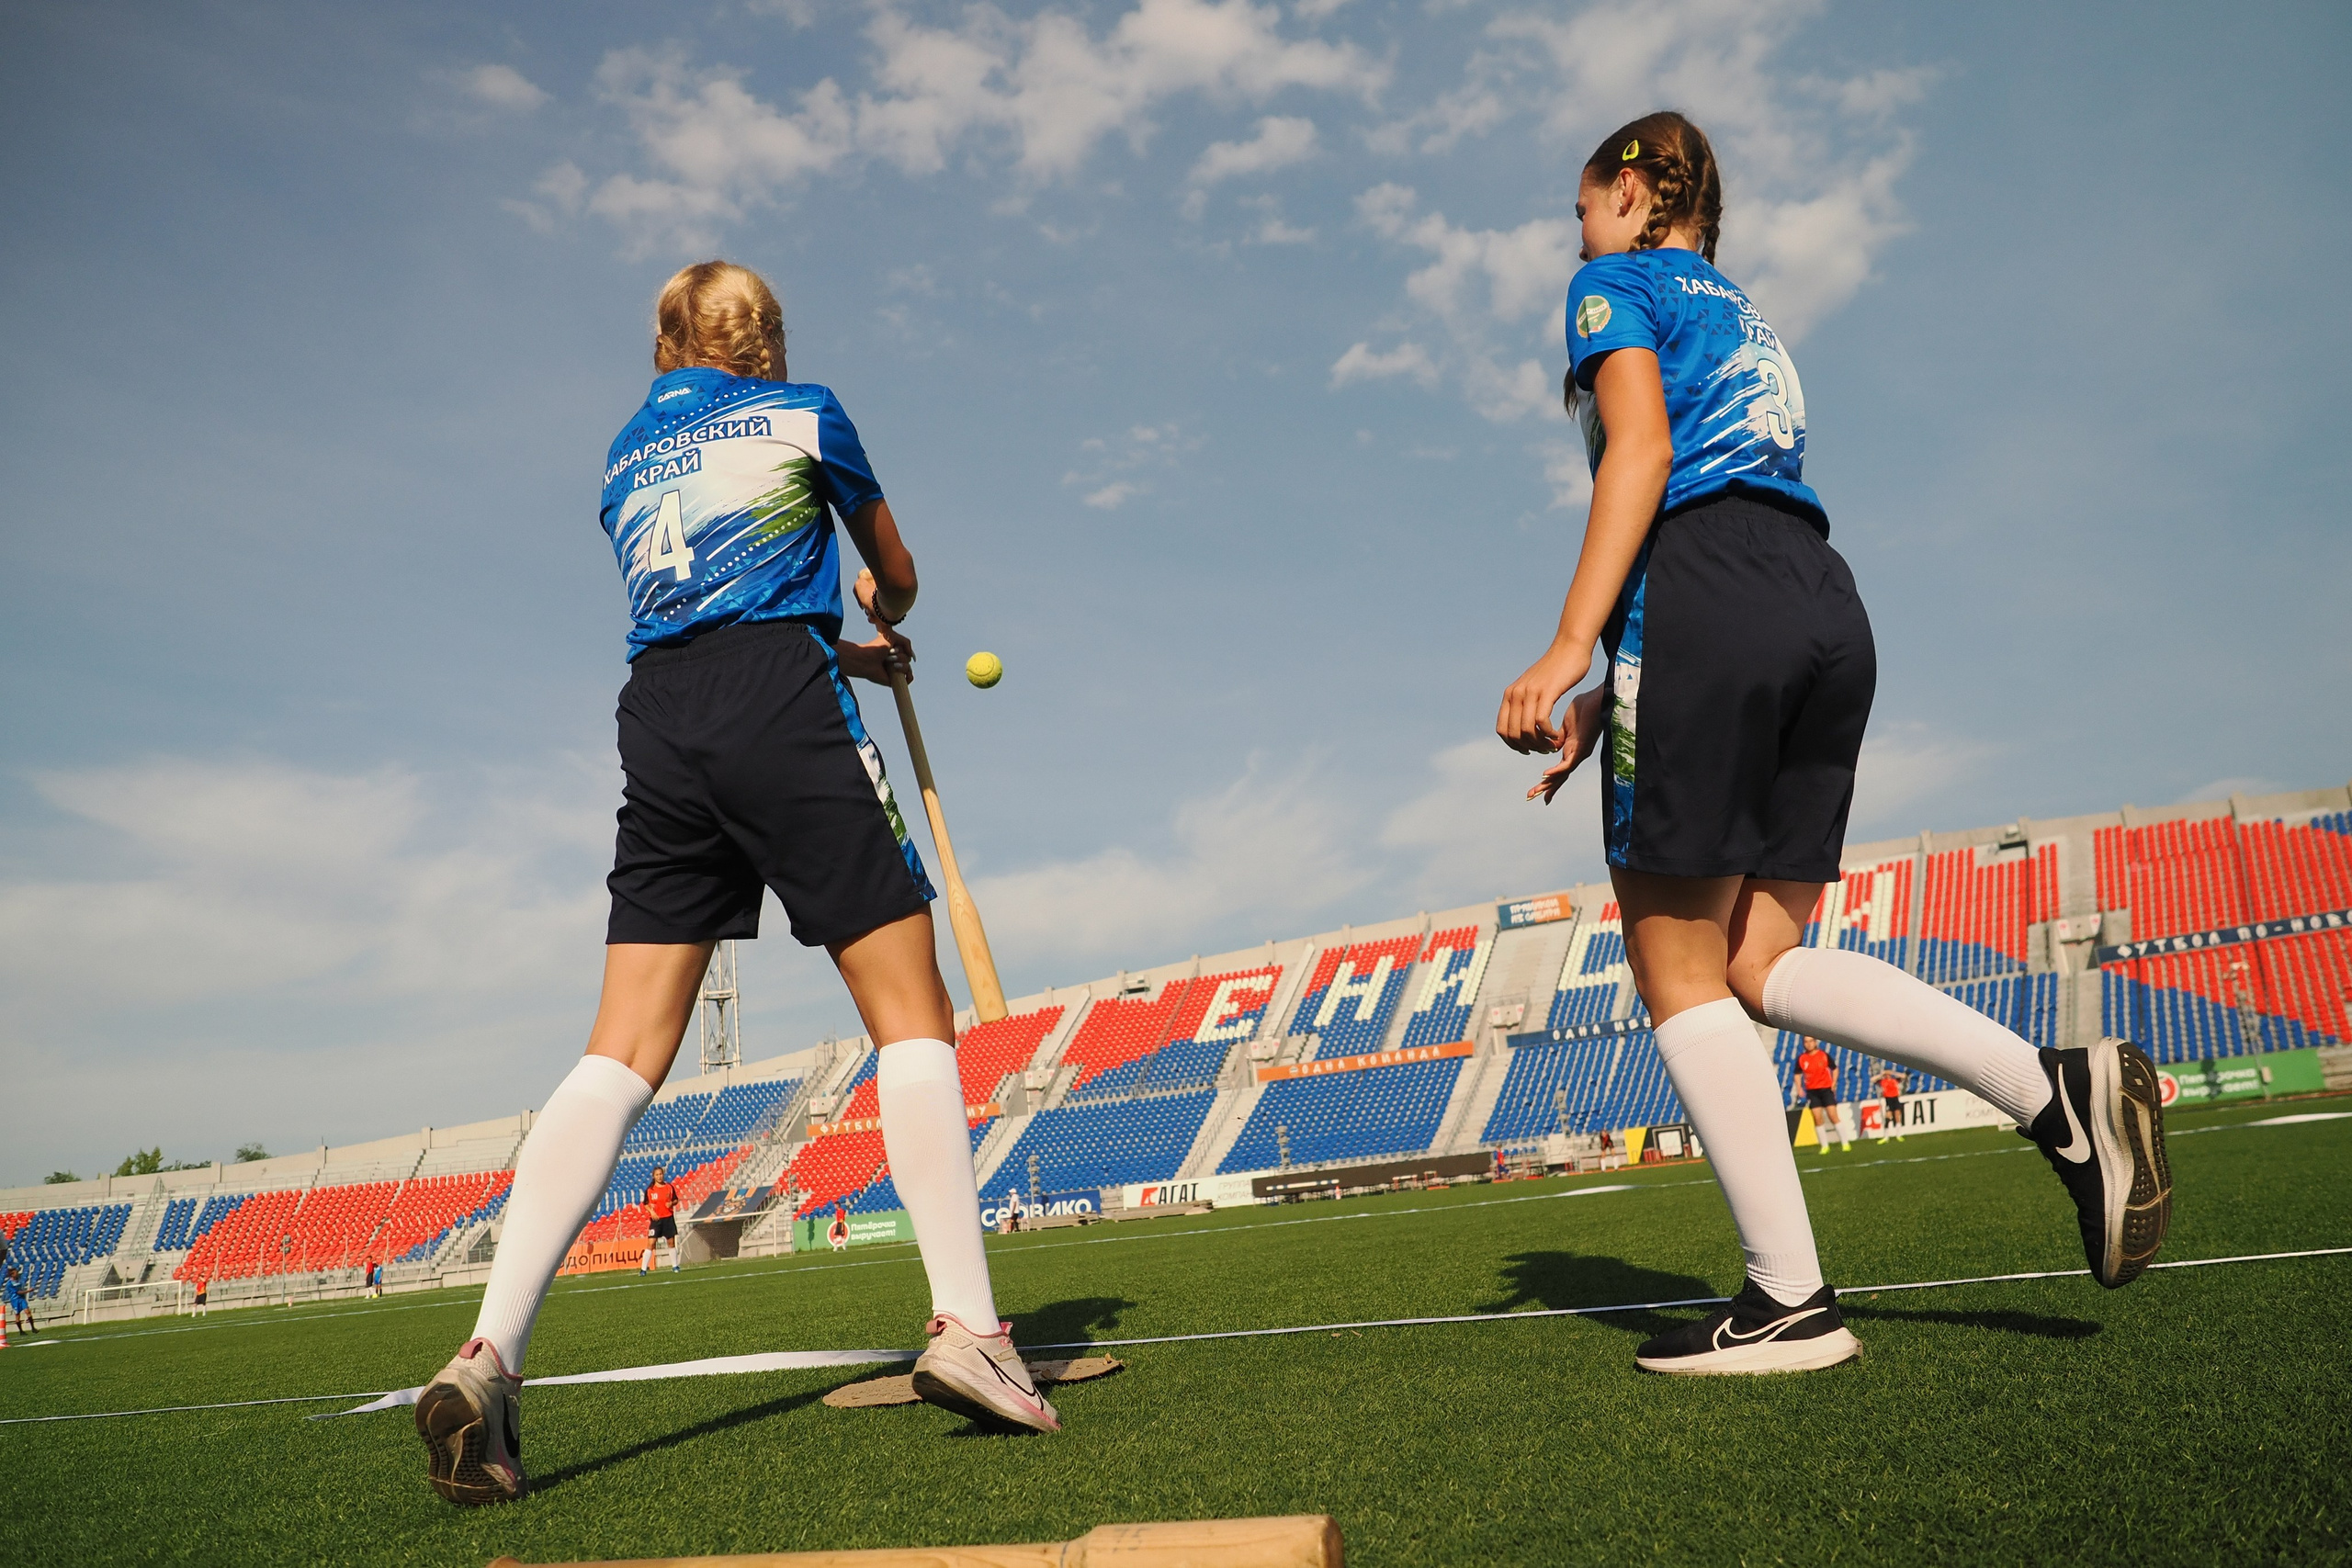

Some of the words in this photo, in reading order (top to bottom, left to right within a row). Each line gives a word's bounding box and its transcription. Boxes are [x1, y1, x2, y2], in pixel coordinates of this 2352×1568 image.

[1674, 276, 1762, 321] ХАБАРОВ
[1757, 357, 1795, 450] 3
[603, 416, 770, 491] ХАБАРОВСКИЙ
[633, 449, 701, 489] КРАЙ
[648, 489, 695, 581] 4
[2117, 931, 2222, 958] ФУТБОЛ
[820, 1119, 882, 1134] ФУТБОЛ
[1158, 1182, 1199, 1204] АГАТ
[1216, 1190, 1253, 1201] КОМПАН
[851, 1220, 897, 1232] Пятёрочка
[851, 1229, 896, 1241] выручает!
